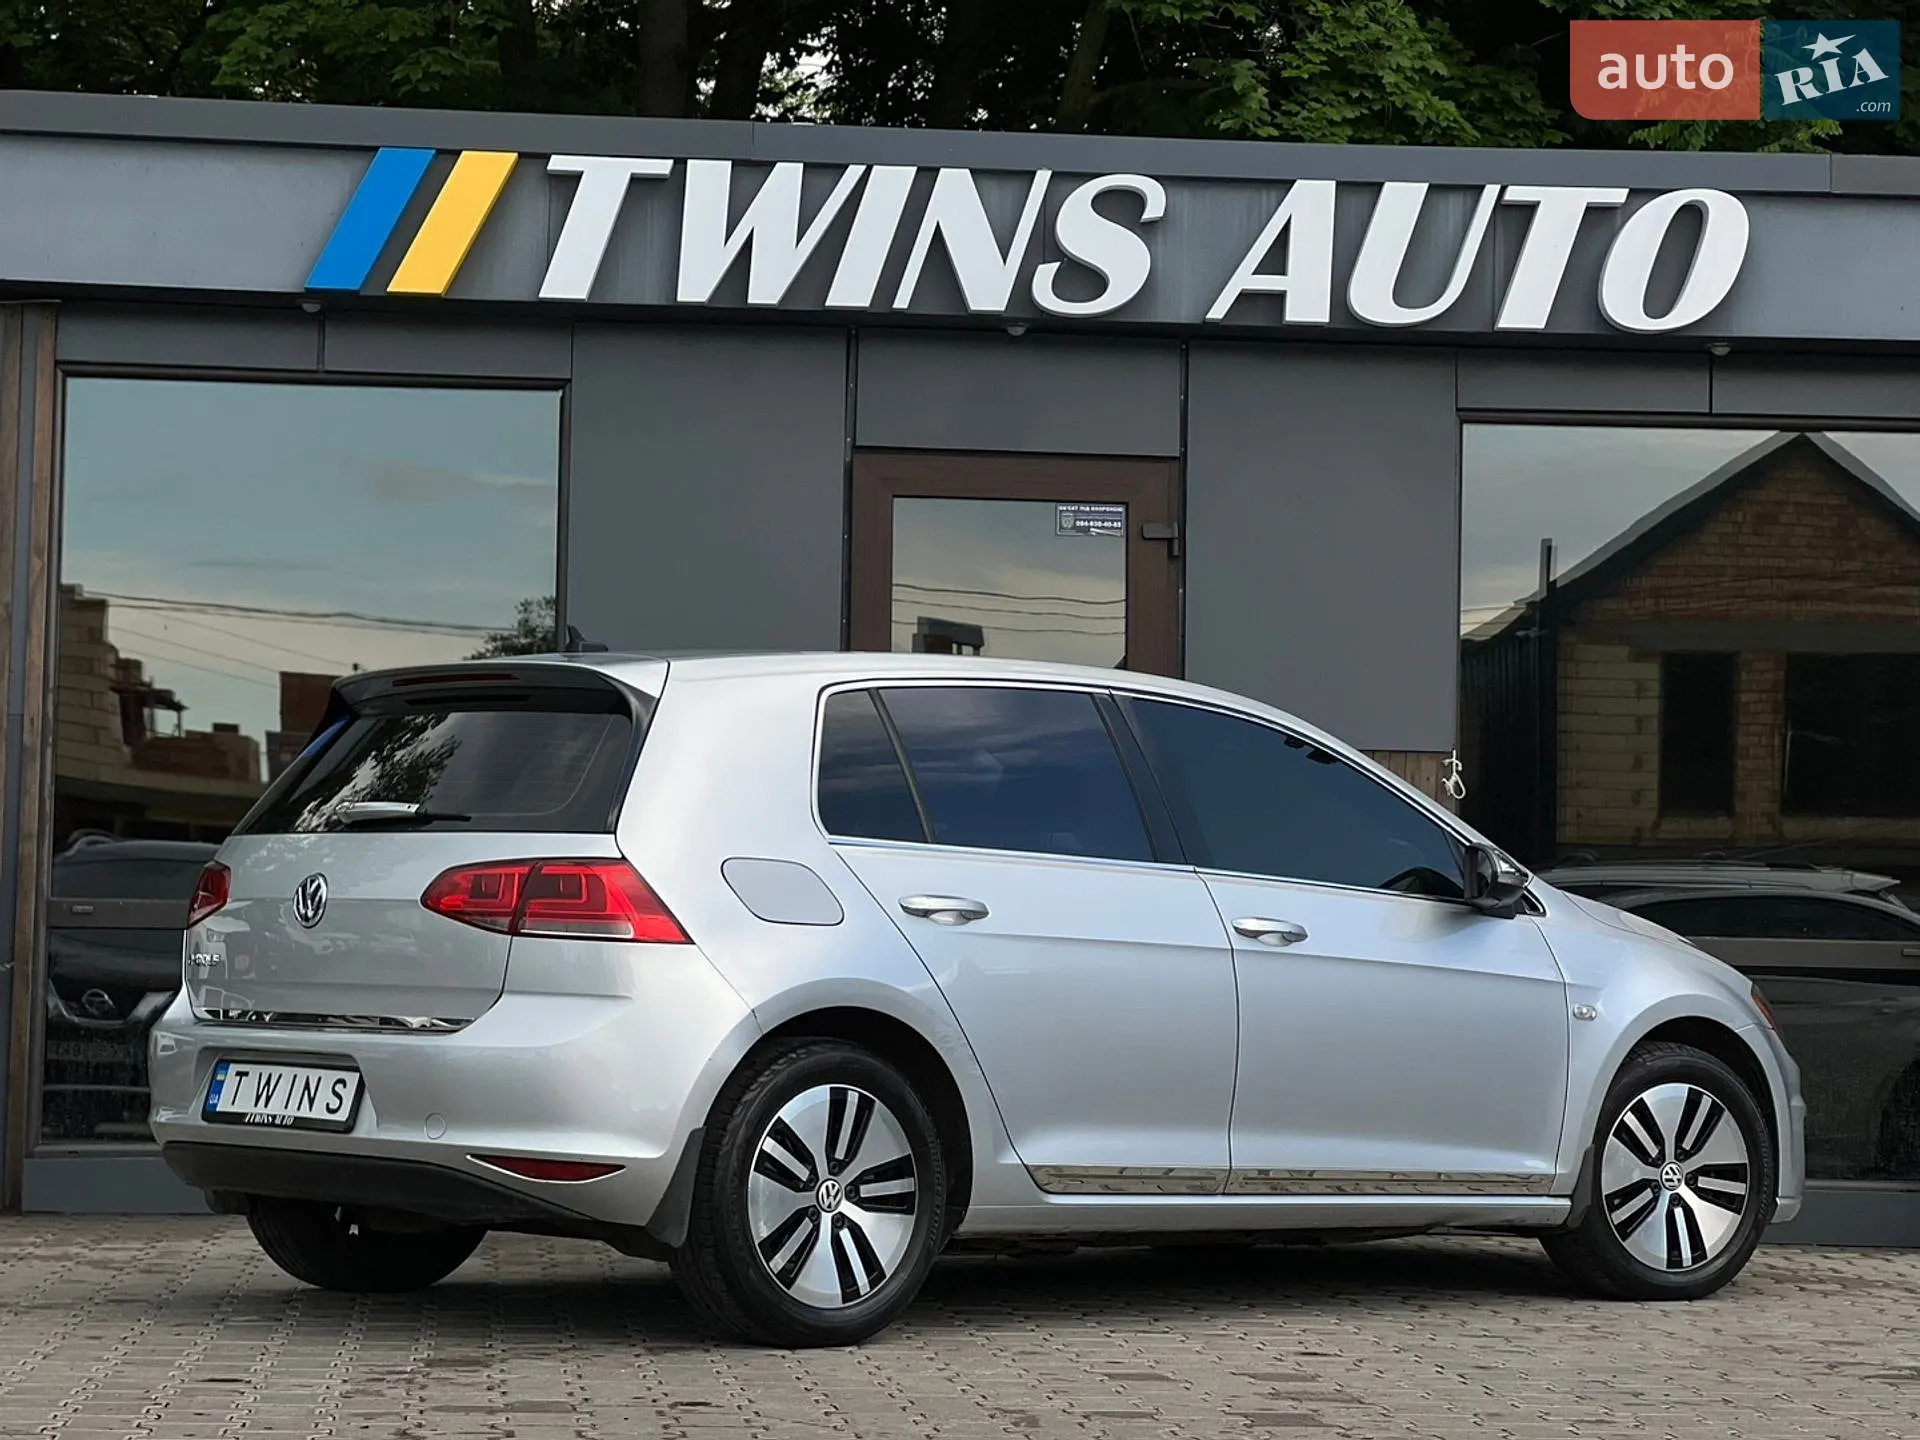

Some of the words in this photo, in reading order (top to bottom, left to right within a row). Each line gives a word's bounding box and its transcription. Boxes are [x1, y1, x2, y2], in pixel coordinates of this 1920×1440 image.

[538, 154, 1167, 317] TWINS
[1204, 179, 1750, 334] AUTO
[231, 1070, 347, 1115] TWINS
